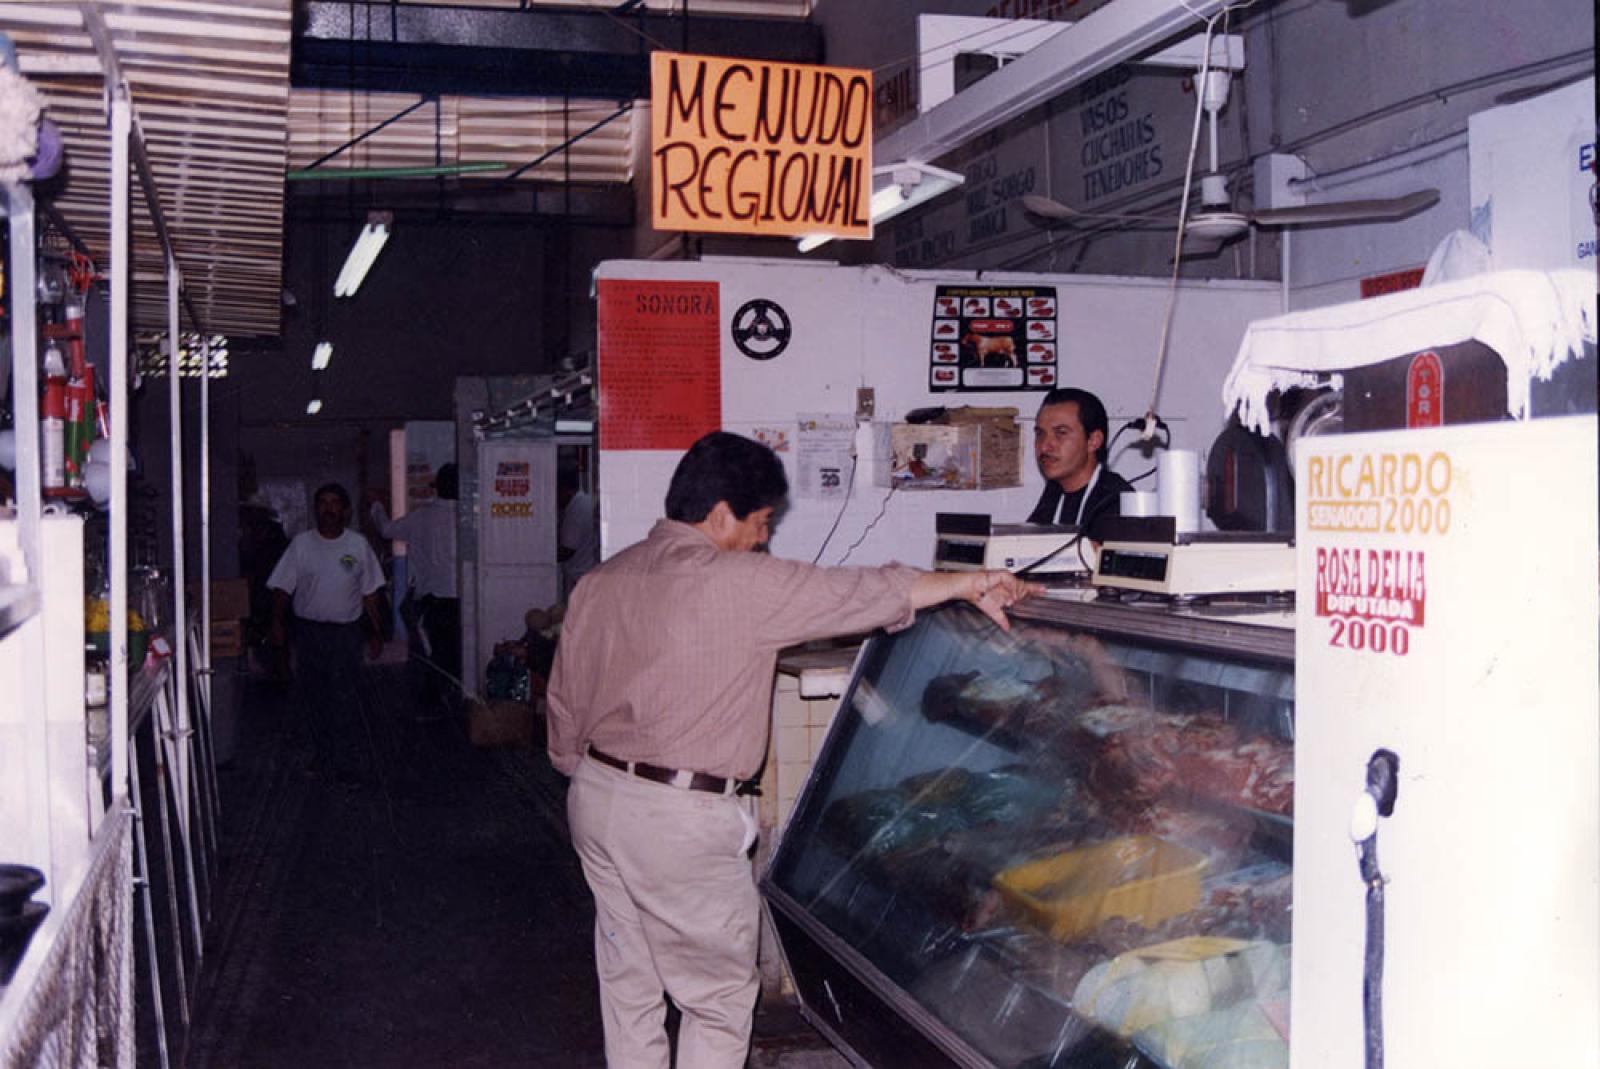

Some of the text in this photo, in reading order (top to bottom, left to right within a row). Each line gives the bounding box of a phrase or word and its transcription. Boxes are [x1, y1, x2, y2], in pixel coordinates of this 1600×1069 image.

[664, 59, 869, 148] MENUDO
[1079, 91, 1129, 136] VASOS
[1081, 112, 1155, 167] CUCHARAS
[655, 141, 869, 226] REGIONAL
[1083, 144, 1163, 202] TENEDORES
[636, 293, 715, 315] SONORA
[1308, 452, 1453, 497] RICARDO
[1384, 498, 1452, 534] 2000
[1316, 548, 1425, 602] ROSA DELIA
[1328, 594, 1415, 620] DIPUTADA
[1328, 619, 1409, 655] 2000
